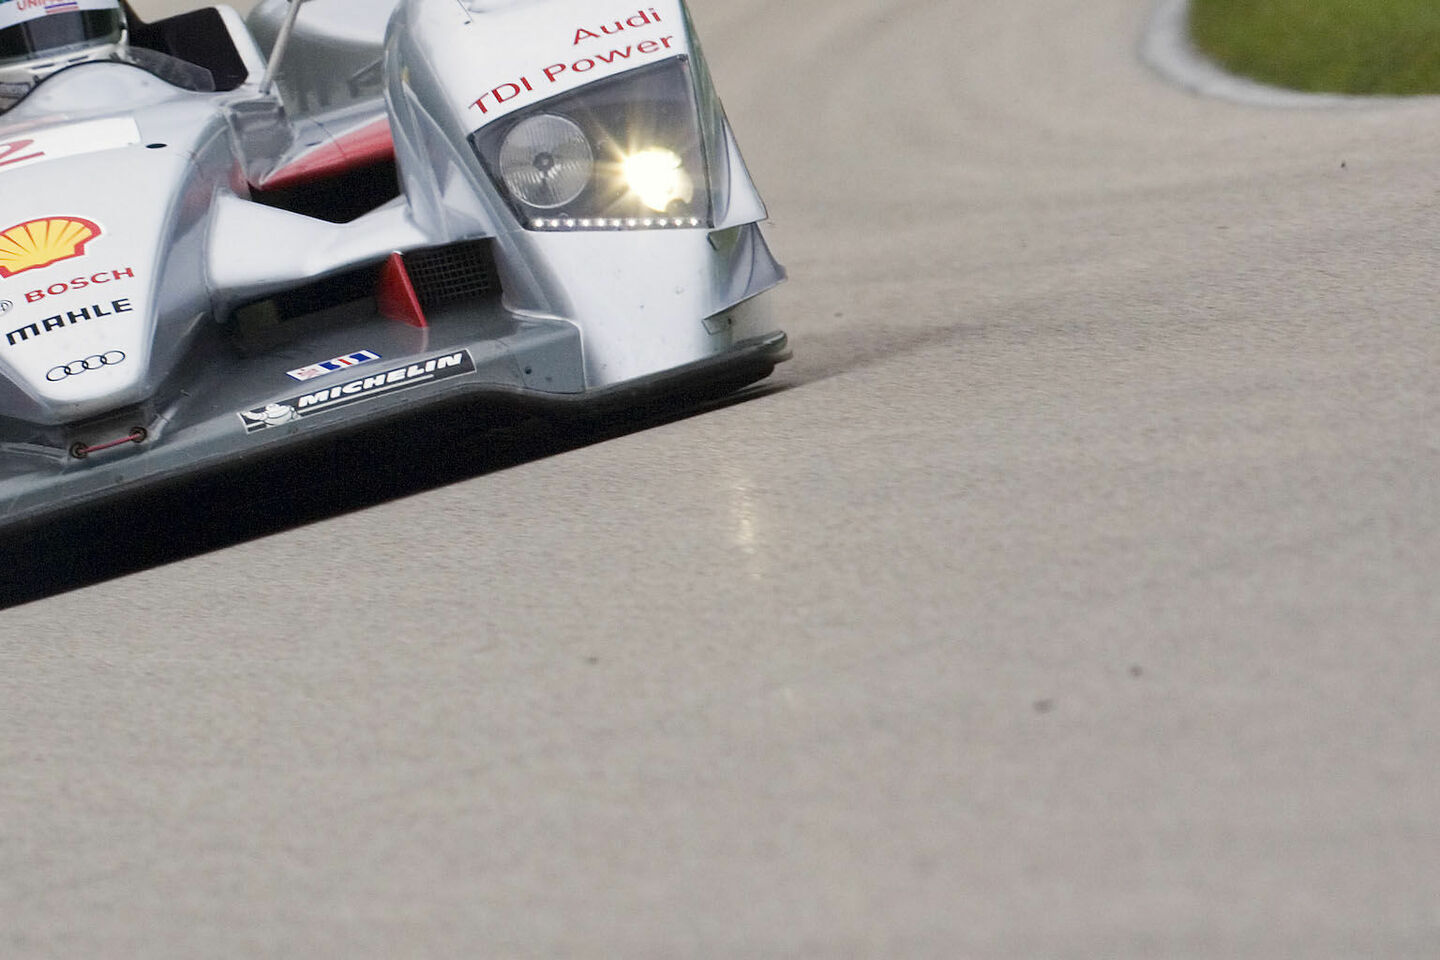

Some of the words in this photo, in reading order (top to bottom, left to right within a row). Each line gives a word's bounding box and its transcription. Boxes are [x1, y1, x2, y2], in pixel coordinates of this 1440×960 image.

[572, 7, 662, 46] Audi
[467, 76, 534, 115] TDI
[541, 34, 674, 83] Power
[24, 267, 135, 304] BOSCH
[5, 298, 134, 346] MAHLE
[297, 352, 463, 408] MICHELIN
